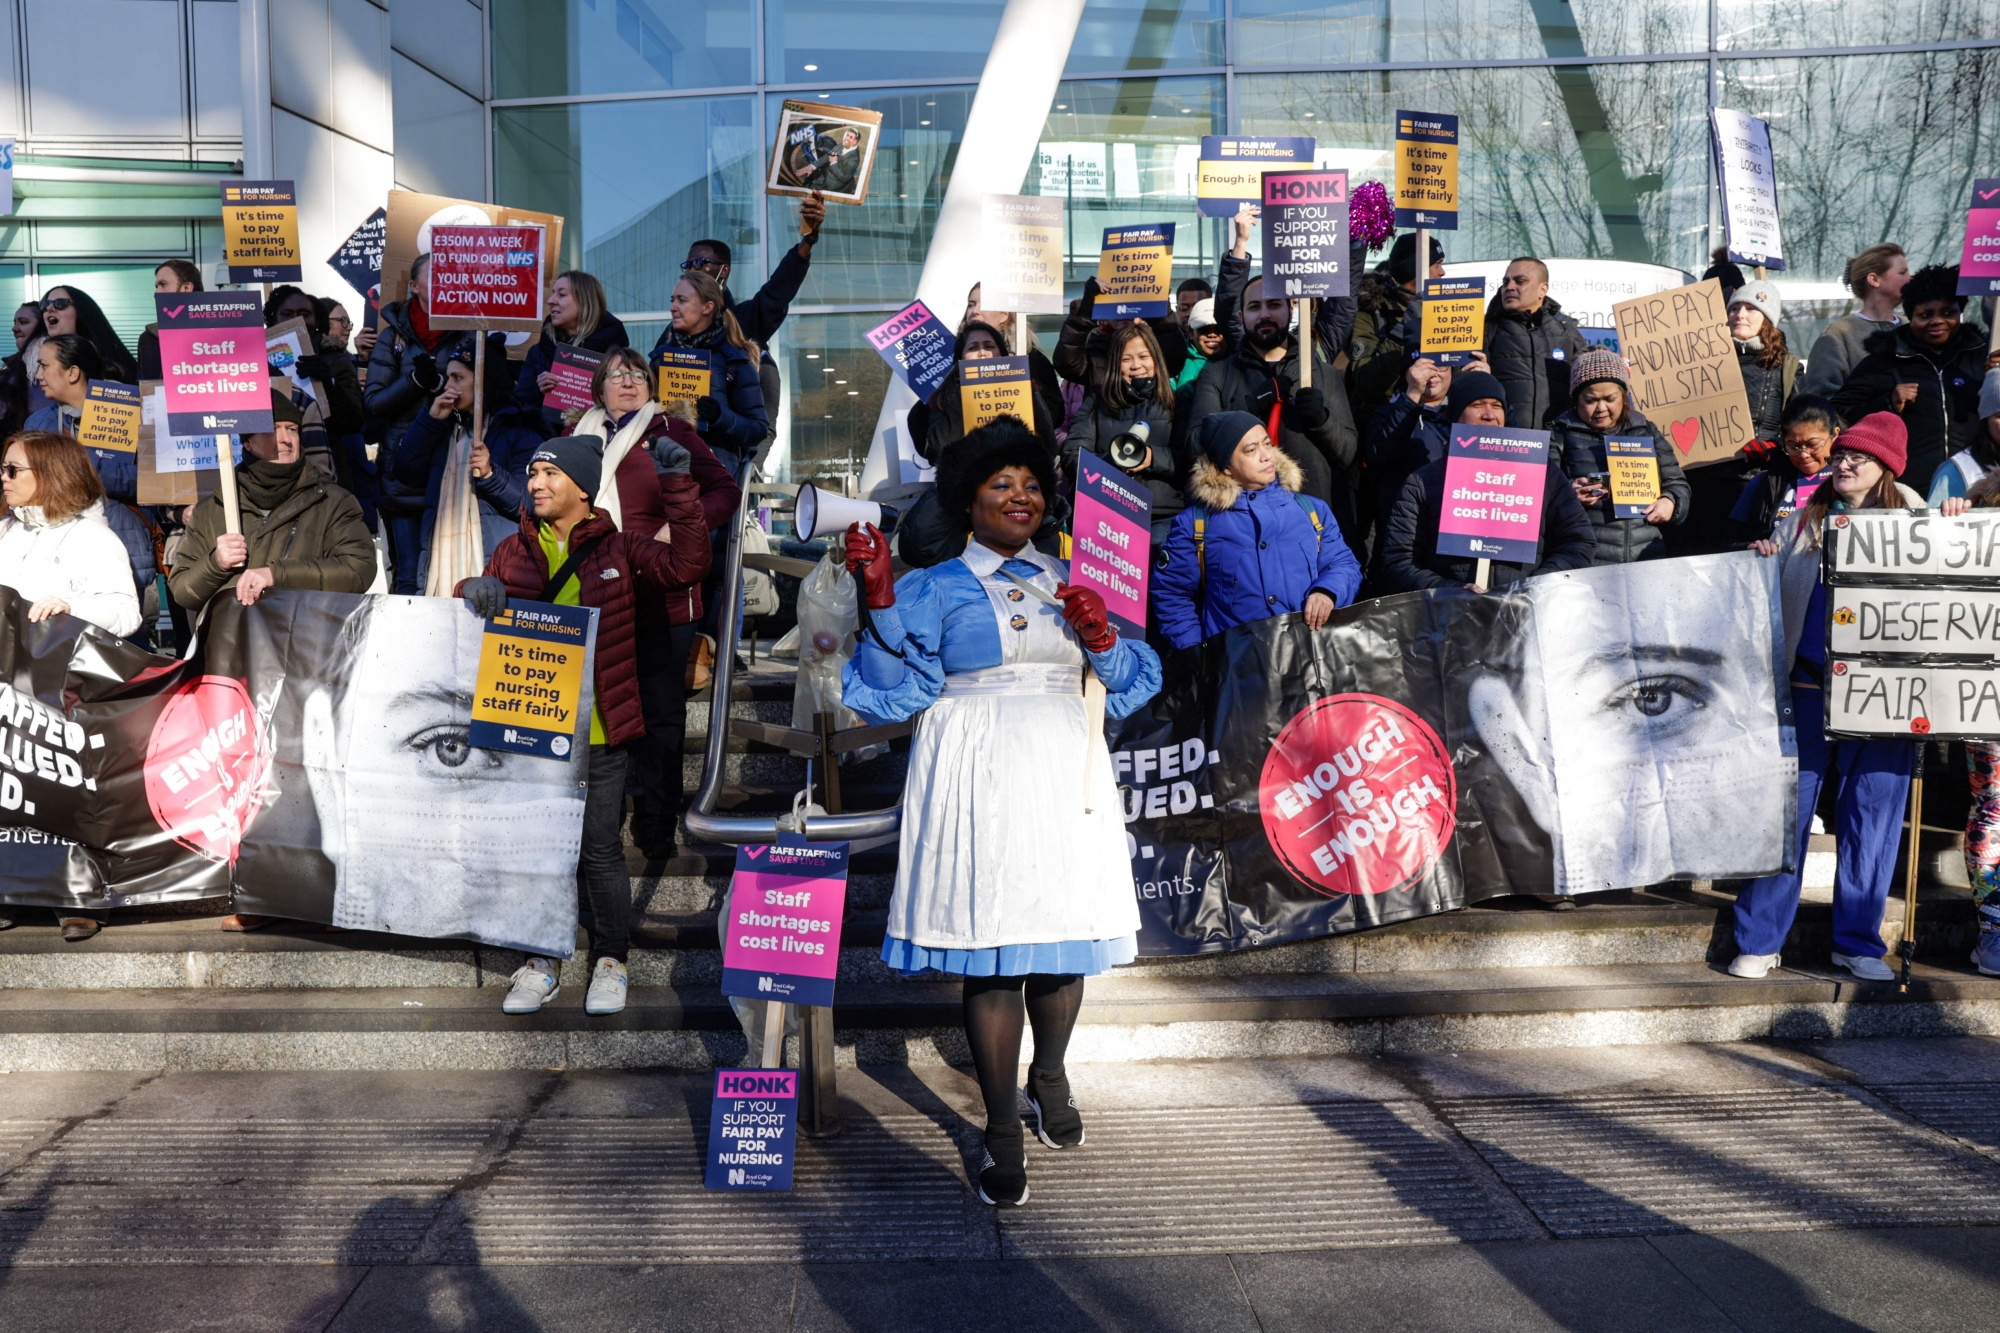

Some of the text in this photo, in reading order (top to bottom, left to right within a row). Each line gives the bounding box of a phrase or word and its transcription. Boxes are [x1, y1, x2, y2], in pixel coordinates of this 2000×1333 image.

[791, 125, 814, 145] NHS
[1406, 147, 1447, 160] It's time
[1412, 162, 1442, 175] to pay
[1741, 158, 1762, 174] LOOKS
[1203, 174, 1257, 184] Enough is
[1408, 176, 1446, 189] nursing
[1271, 180, 1340, 199] HONK
[1401, 189, 1452, 203] staff fairly
[1284, 207, 1327, 219] IF YOU
[1274, 220, 1337, 234] SUPPORT
[240, 235, 285, 246] nursing
[434, 236, 522, 248] £350M A WEEK
[1019, 231, 1049, 242] time
[1275, 234, 1337, 247] FAIR PAY
[234, 247, 294, 258] staff fairly
[433, 253, 534, 264] TO FUND OUR NHS
[1019, 247, 1043, 258] pay
[1112, 252, 1159, 262] It's time
[1291, 249, 1320, 260] FOR
[1274, 262, 1338, 275] NURSING
[438, 273, 517, 285] YOUR WORDS
[1022, 273, 1056, 286] fairly
[1111, 274, 1156, 284] nursing
[1132, 285, 1162, 294] fairly
[1584, 278, 1636, 295] Hospital
[437, 291, 528, 305] ACTION NOW
[1619, 300, 1670, 340] FAIR
[1672, 285, 1717, 327] PAY
[874, 308, 926, 344] HONK
[1434, 325, 1472, 334] nursing
[895, 327, 927, 350] IF YOU
[1426, 335, 1478, 344] staff fairly
[192, 341, 235, 355] Staff
[895, 329, 940, 363] SUPPORT
[902, 337, 946, 369] FAIR PAY
[1628, 323, 1730, 375] AND NURSES
[920, 352, 943, 369] FOR
[172, 362, 259, 376] shortages
[667, 371, 701, 381] It's time
[177, 378, 257, 394] cost lives
[1630, 360, 1724, 411] WILL STAY
[974, 387, 1020, 399] It's time
[980, 402, 1015, 412] to pay
[91, 424, 128, 436] nursing
[1700, 405, 1745, 450] NHS
[83, 432, 133, 446] staff fairly
[176, 437, 209, 450] Who'll
[176, 457, 211, 466] to care
[1475, 471, 1516, 486] Staff
[1620, 480, 1651, 488] nursing
[1452, 487, 1533, 506] shortages
[1637, 490, 1657, 499] fairly
[1453, 507, 1528, 523] cost lives
[1098, 521, 1130, 550] Staff
[1846, 519, 1931, 567] NHS
[1080, 537, 1142, 580] shortages
[1080, 562, 1139, 601] cost lives
[516, 610, 561, 624] FAIR PAY
[516, 620, 581, 636] FOR NURSING
[498, 643, 567, 664] It's time
[504, 663, 557, 684] to pay
[495, 681, 560, 703] nursing
[1844, 674, 1928, 720] FAIR
[482, 697, 569, 722] staff fairly
[1274, 718, 1406, 820] ENOUGH
[1337, 778, 1374, 816] IS
[1310, 774, 1441, 877] ENOUGH
[770, 846, 841, 859] SAFE STAFFING
[764, 890, 811, 908] Staff
[739, 910, 830, 934] shortages
[740, 936, 824, 955] cost lives
[722, 1077, 790, 1093] HONK
[734, 1101, 776, 1112] IF YOU
[722, 1114, 786, 1126] SUPPORT
[722, 1127, 784, 1138] FAIR PAY
[737, 1140, 766, 1151] FOR
[718, 1153, 782, 1165] NURSING
